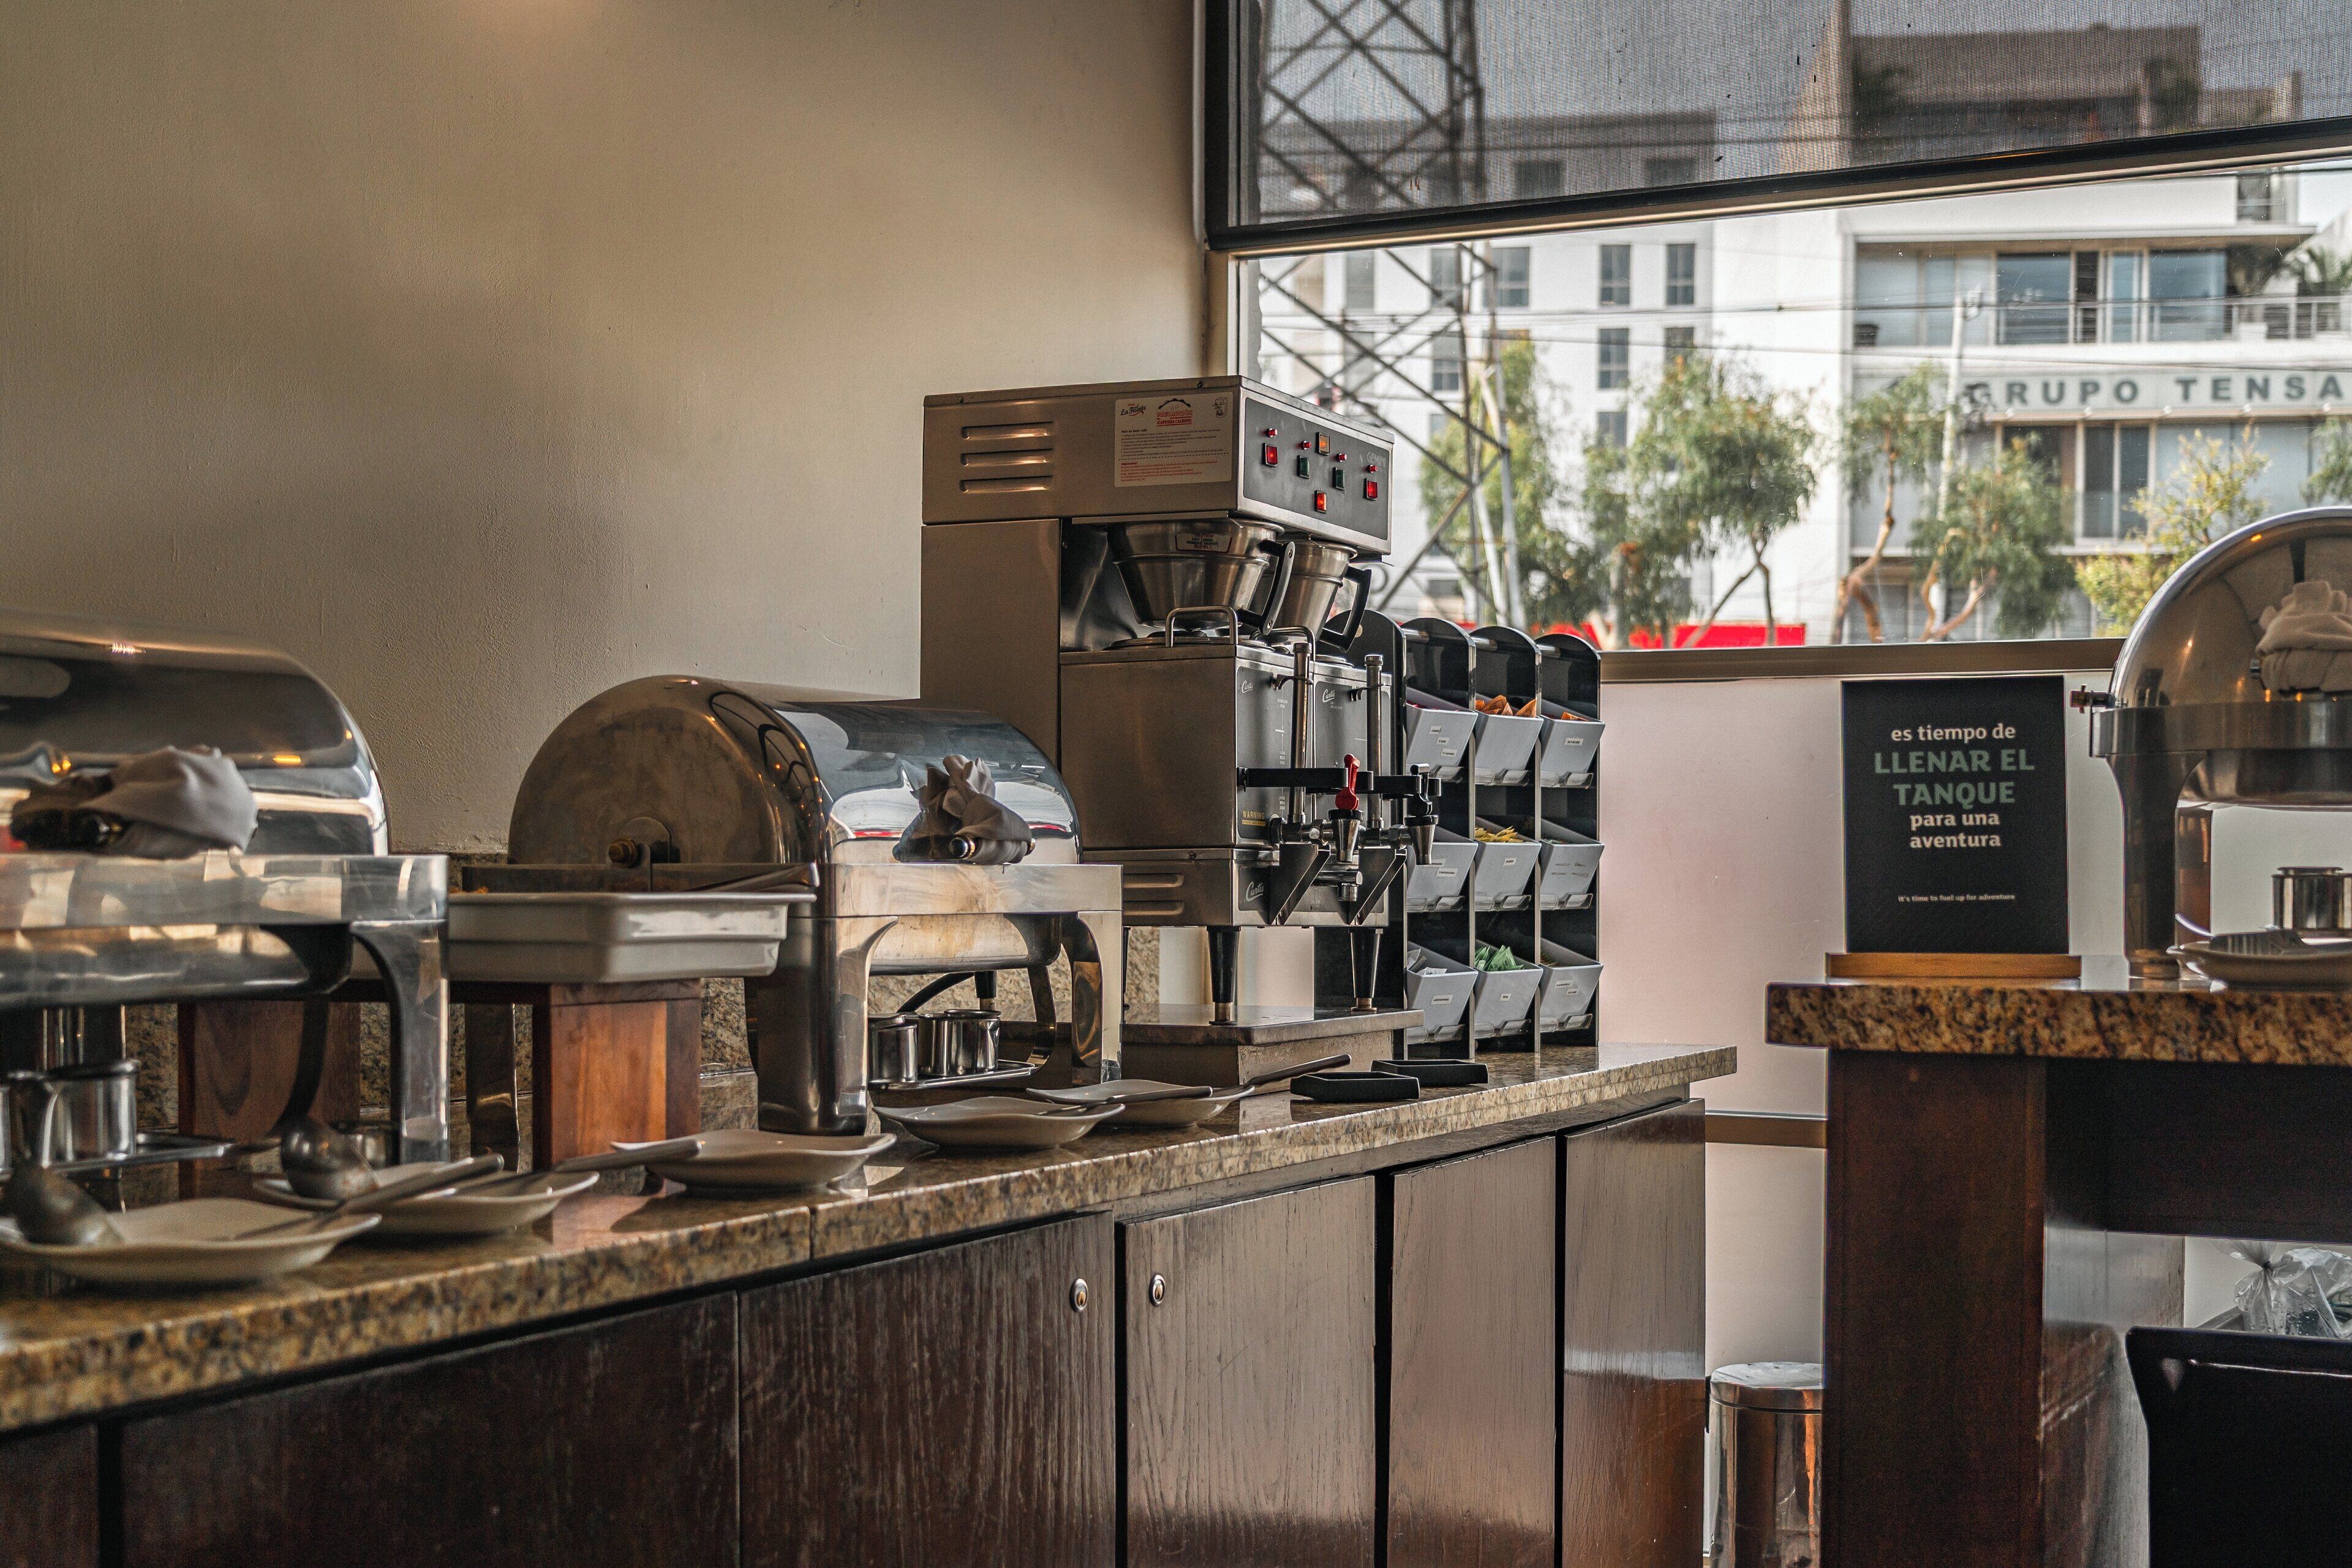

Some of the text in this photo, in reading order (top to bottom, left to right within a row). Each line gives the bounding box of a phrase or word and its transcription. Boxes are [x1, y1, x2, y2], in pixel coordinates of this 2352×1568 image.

[2176, 374, 2343, 402] TENSA
[1156, 409, 1193, 417] PRECAUCIÓN
[1366, 451, 1386, 468] GEMINI
[1322, 688, 1335, 703] Curtis
[1891, 723, 2016, 743] es tiempo de
[1874, 748, 2034, 774] LLENAR EL
[1893, 781, 2015, 809] TANQUE
[1242, 810, 1265, 820] WARNING
[1910, 813, 2000, 831] para una
[1910, 832, 2001, 848] aventura
[1245, 881, 1264, 902] Curtis
